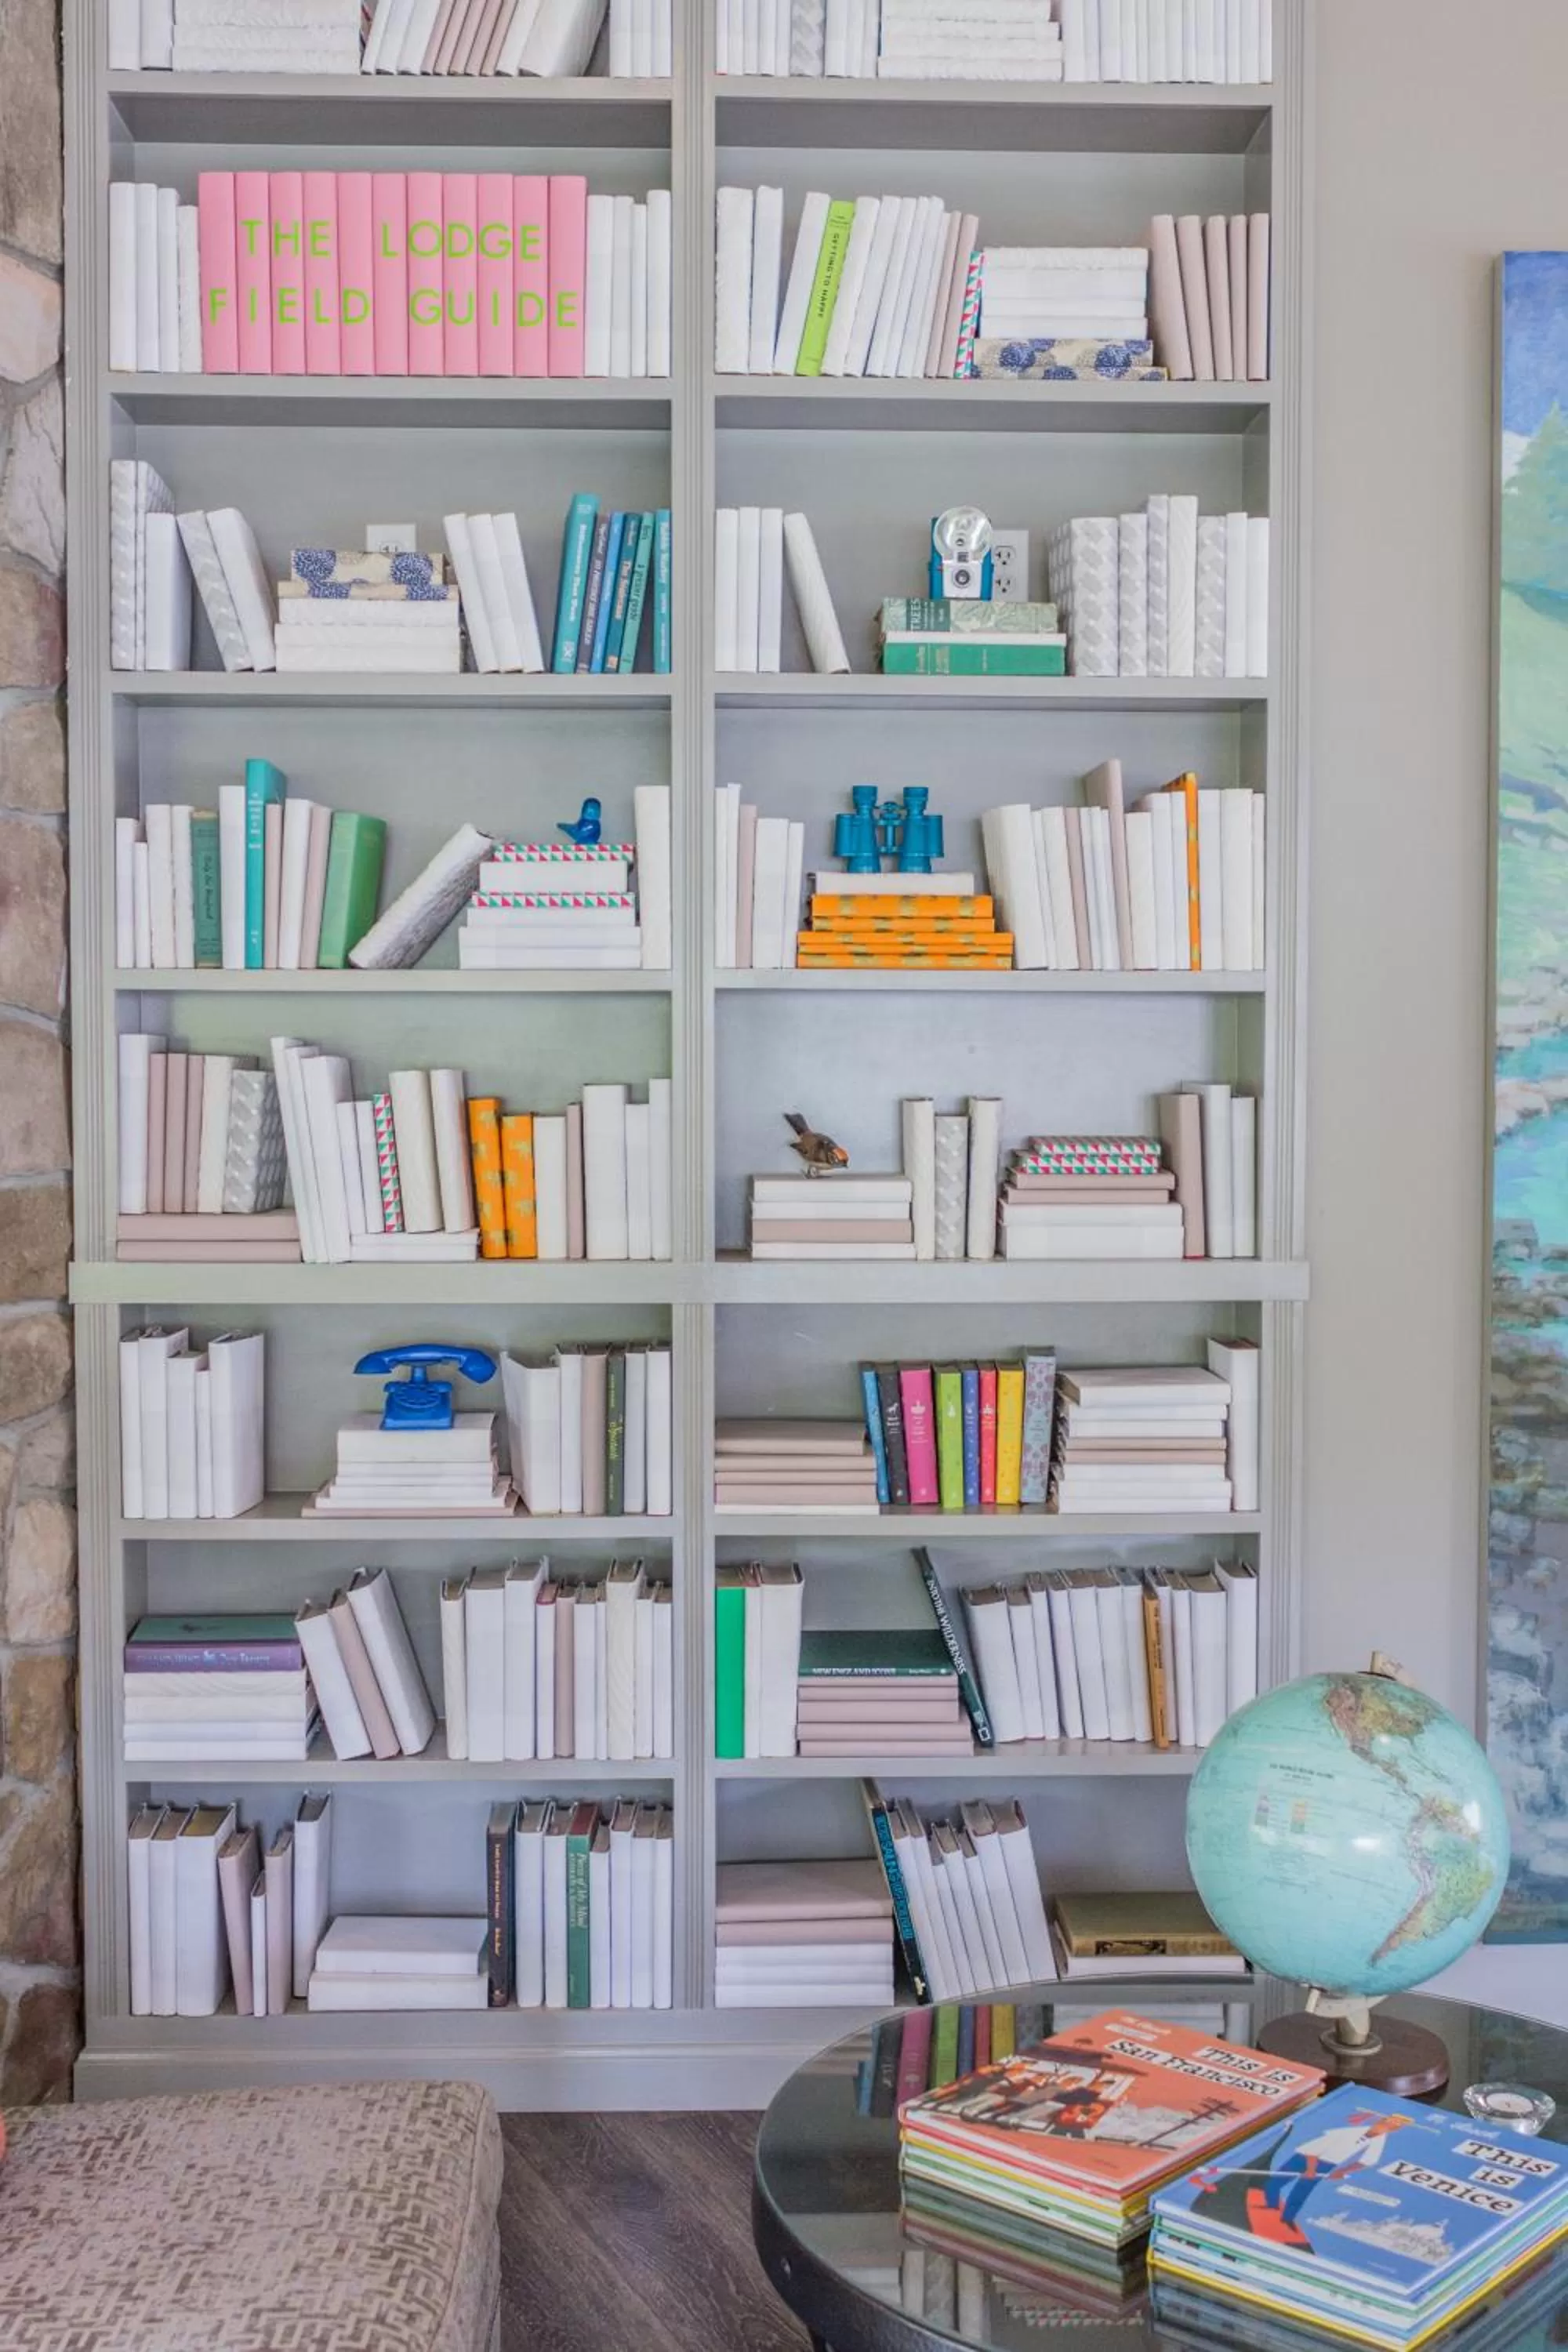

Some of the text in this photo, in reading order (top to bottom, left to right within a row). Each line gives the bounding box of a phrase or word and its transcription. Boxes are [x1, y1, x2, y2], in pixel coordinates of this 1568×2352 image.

[240, 219, 541, 260] THE LODGE
[209, 287, 579, 328] FIELD GUIDE
[909, 598, 921, 630] TREES
[938, 1613, 967, 1675] WILDERNESS
[1110, 2040, 1280, 2096] San Francisco
[1200, 2046, 1294, 2082] This is
[1467, 2141, 1552, 2174] This
[1475, 2169, 1515, 2187] is
[1391, 2161, 1513, 2213] Venice
